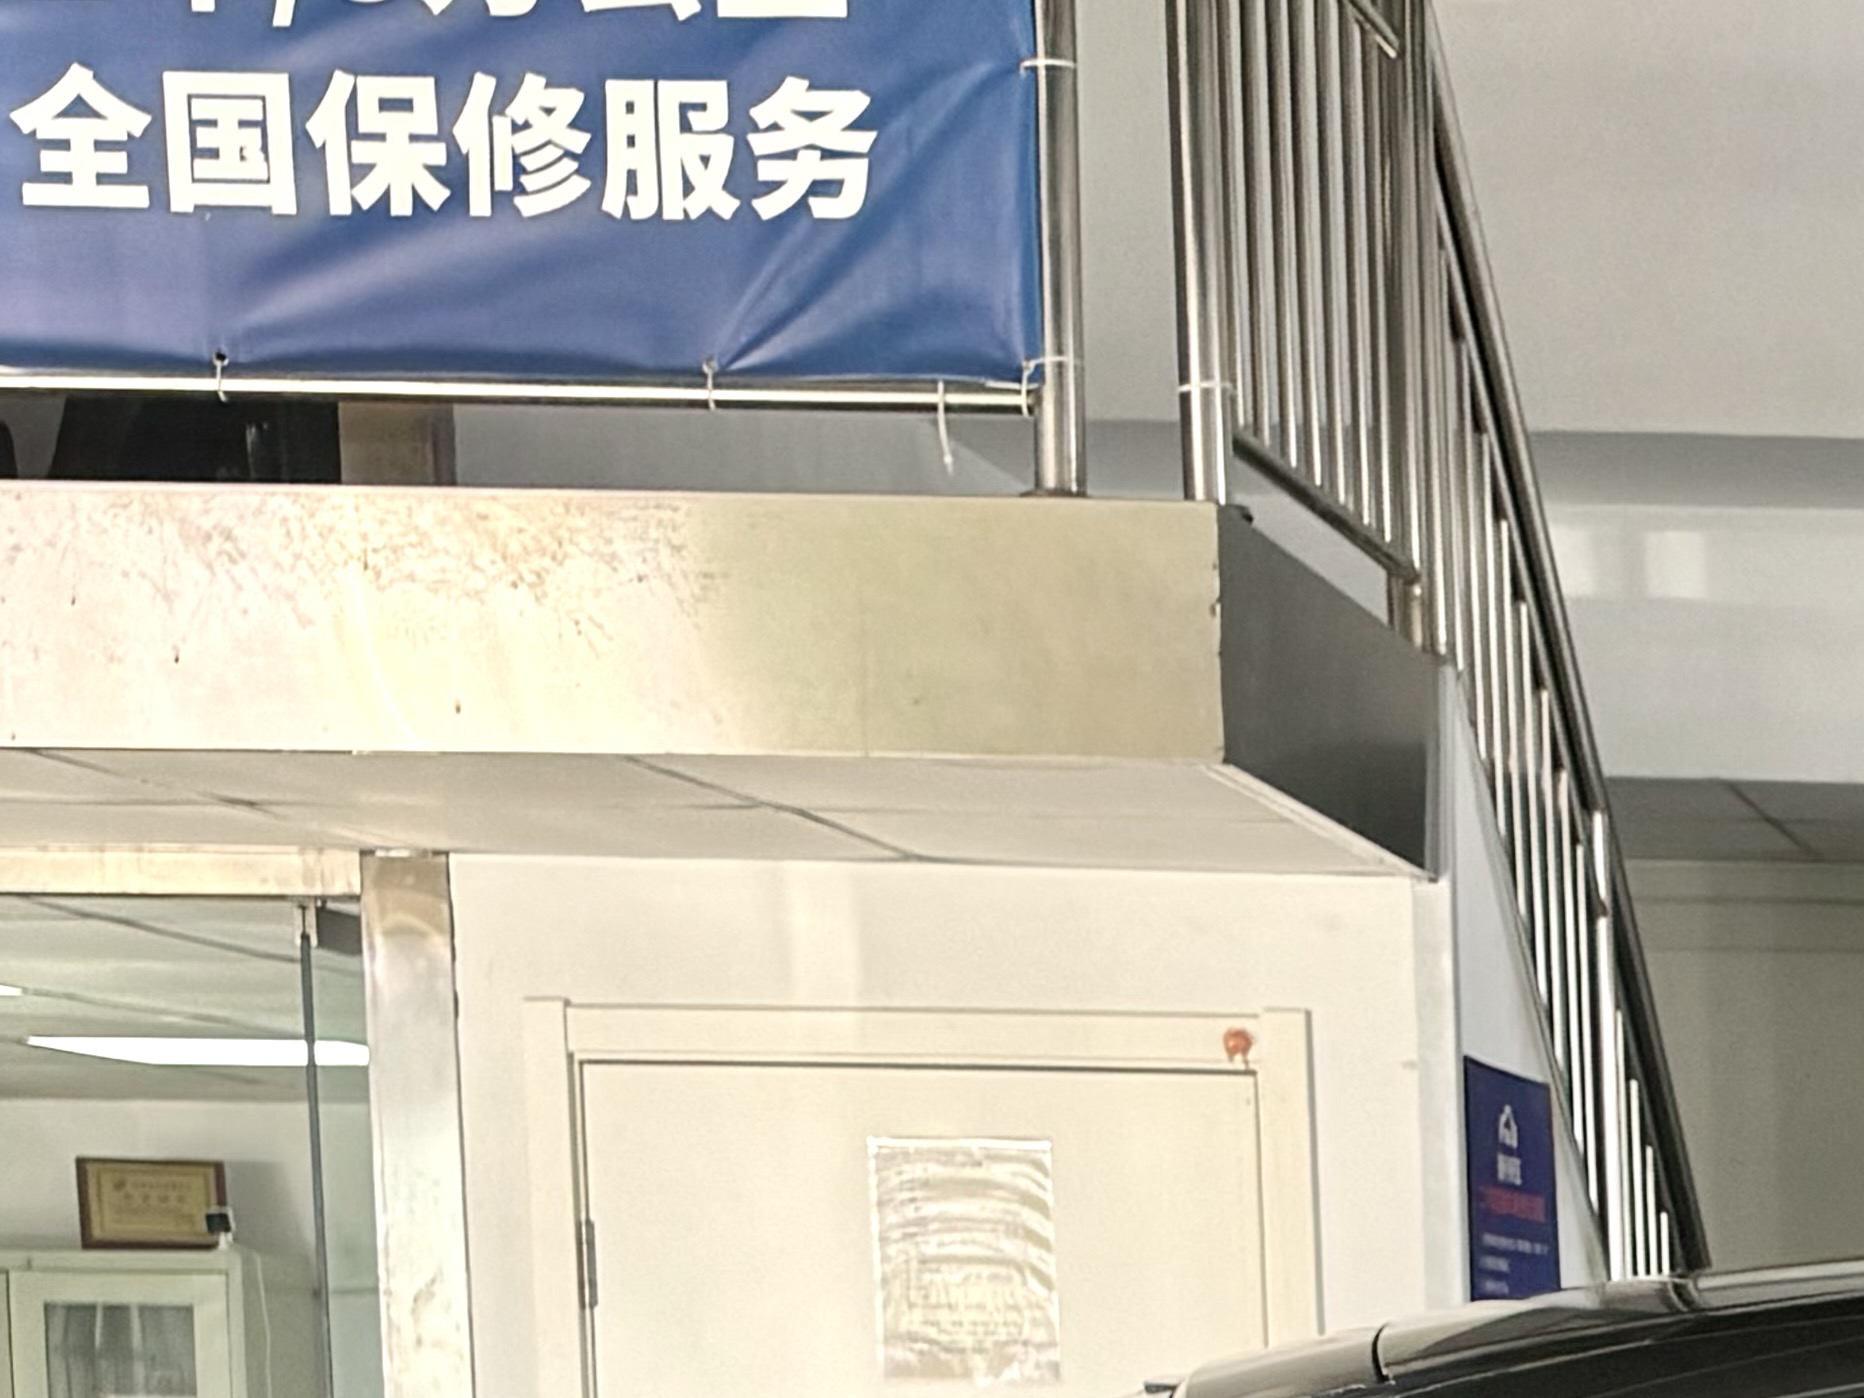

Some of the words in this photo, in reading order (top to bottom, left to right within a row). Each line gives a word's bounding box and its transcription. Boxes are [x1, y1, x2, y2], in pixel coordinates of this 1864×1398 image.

[9, 61, 878, 221] 全国保修服务
